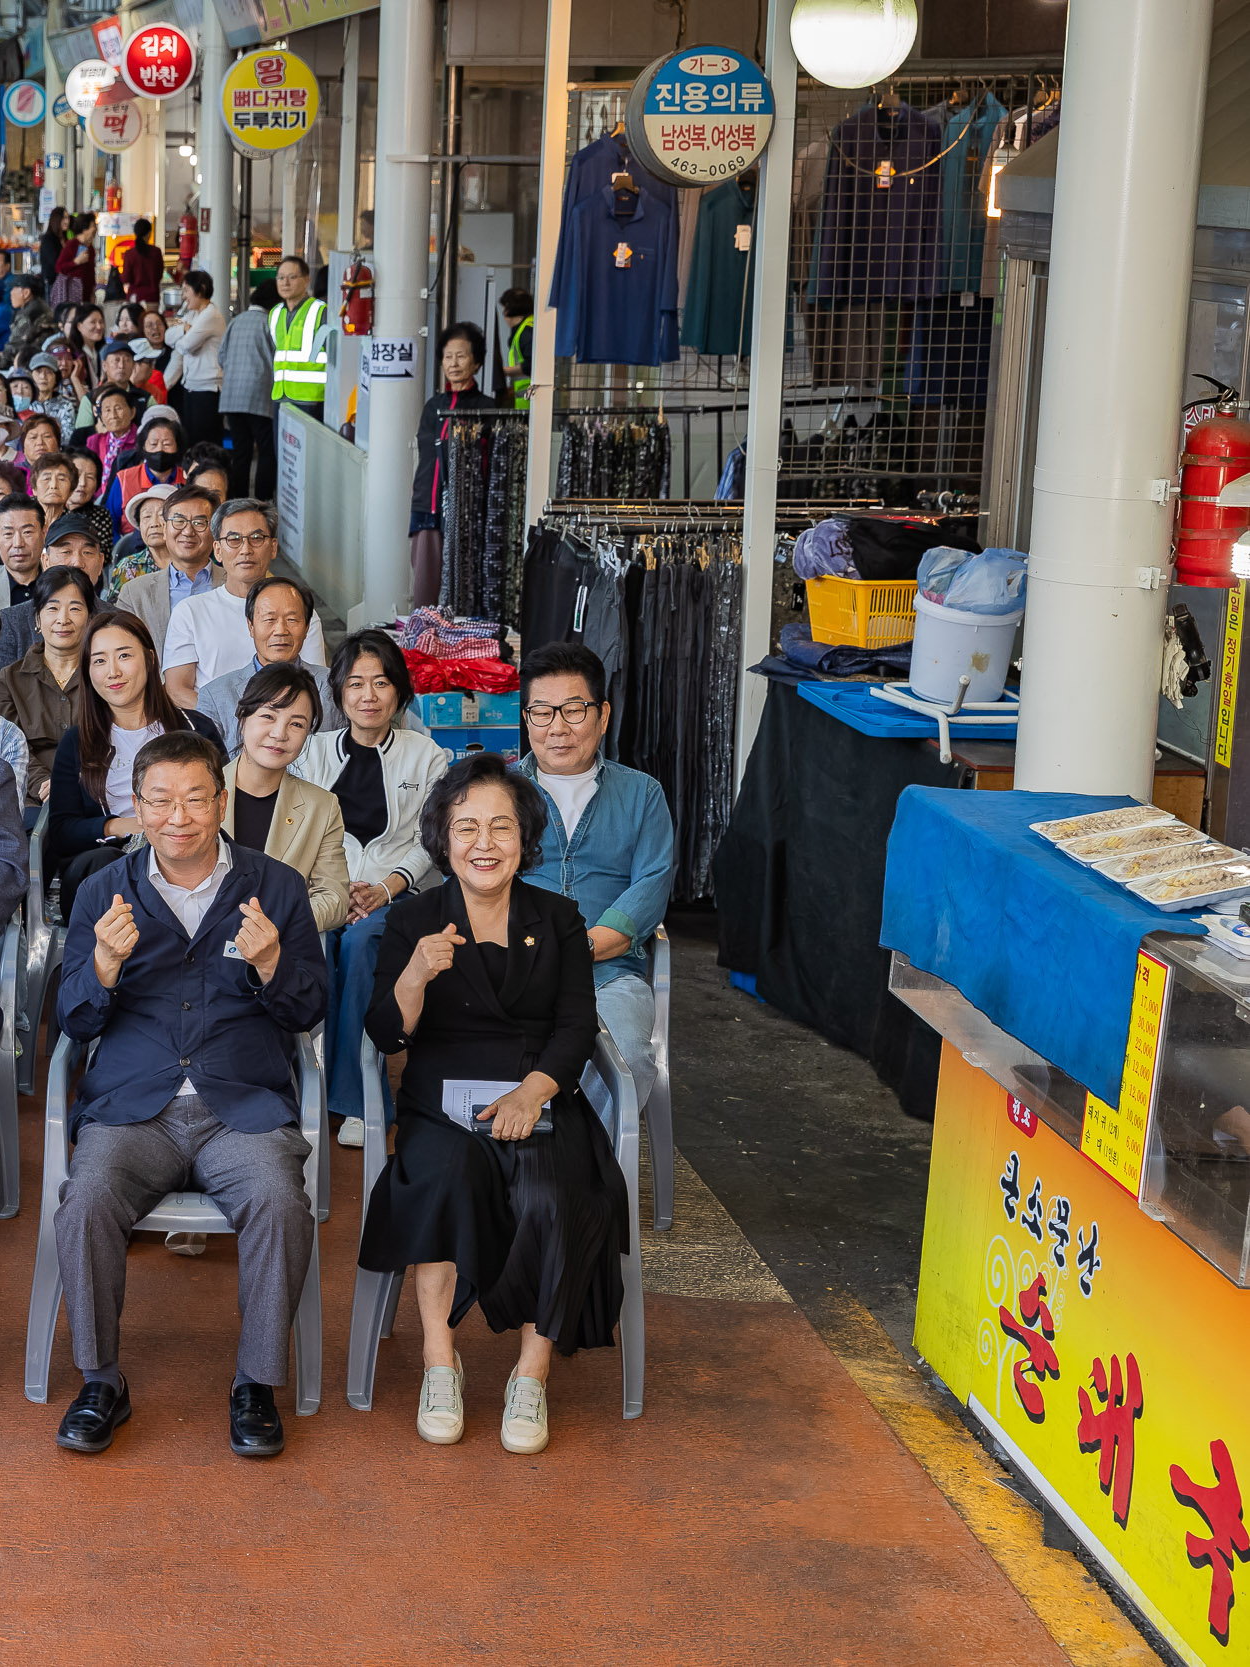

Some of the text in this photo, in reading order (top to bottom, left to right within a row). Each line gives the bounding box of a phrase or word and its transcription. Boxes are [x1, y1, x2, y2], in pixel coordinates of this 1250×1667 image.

[140, 34, 178, 58] 김치
[139, 65, 179, 88] 반찬
[256, 57, 285, 86] 왕
[655, 82, 765, 113] 진용의류
[104, 114, 128, 139] 떡
[233, 111, 307, 130] 두루치기
[670, 155, 746, 177] 463-0069
[371, 342, 413, 362] 화장실
[1140, 995, 1159, 1016] 17,000
[1132, 1059, 1150, 1081] 12,000
[1129, 1084, 1147, 1107] 12,000
[1125, 1135, 1141, 1156] 6,000
[1123, 1160, 1138, 1181] 4,000
